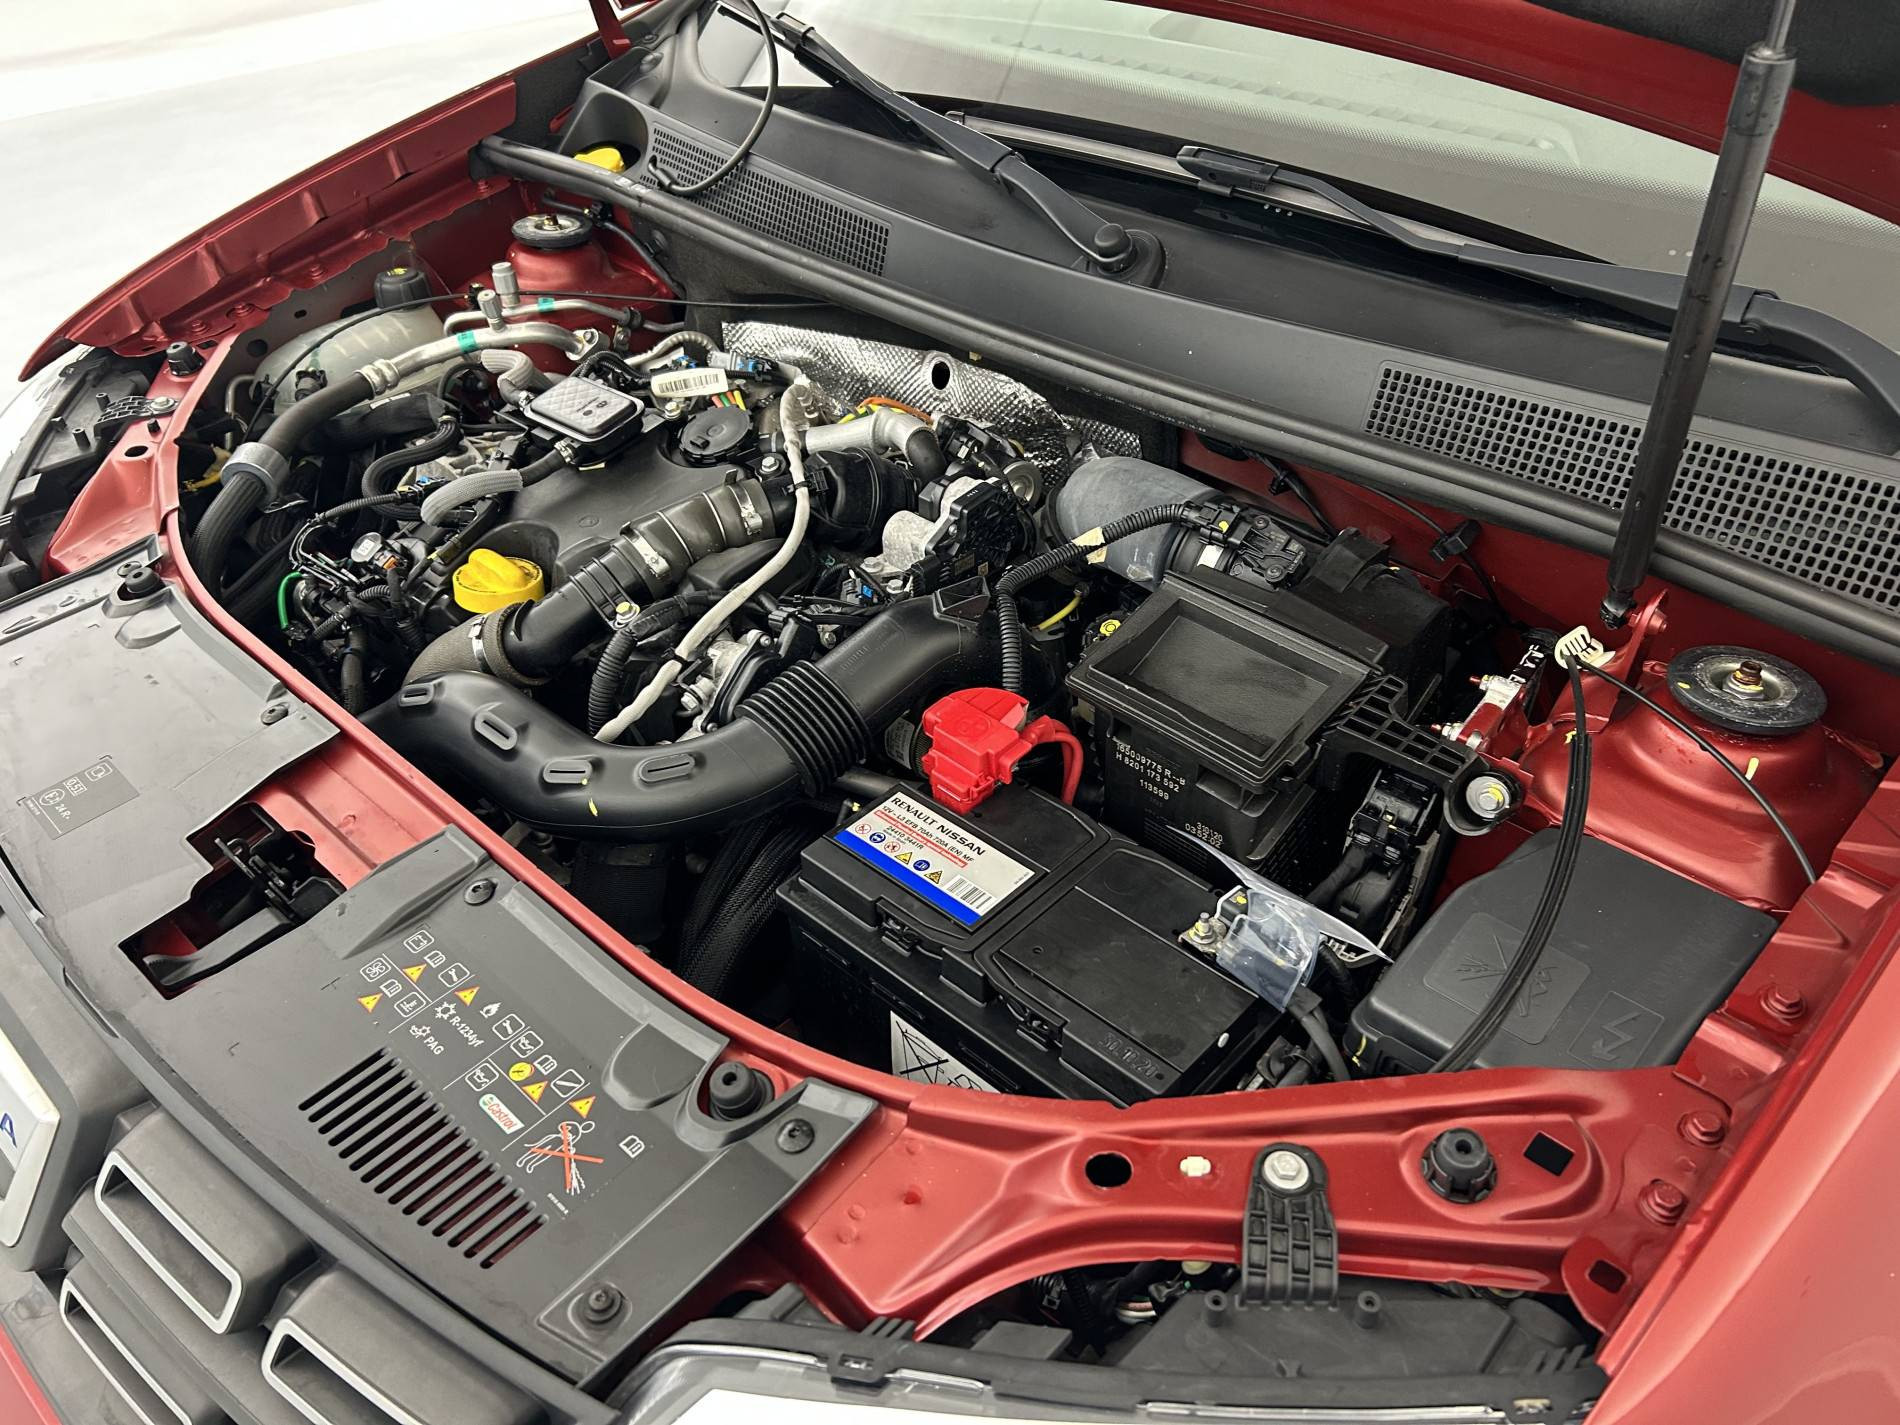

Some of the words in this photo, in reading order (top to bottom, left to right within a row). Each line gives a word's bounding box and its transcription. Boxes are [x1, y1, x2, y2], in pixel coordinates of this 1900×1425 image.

[1116, 752, 1122, 761] H
[1124, 757, 1144, 773] 8201
[1147, 769, 1161, 782] 173
[882, 805, 894, 814] 12V
[905, 818, 918, 829] EFB
[918, 826, 933, 839] 70Ah
[933, 836, 948, 848] 720A
[948, 845, 963, 856] (EN)
[962, 854, 975, 862] MF
[886, 826, 905, 839] 24410
[904, 836, 924, 850] 3441R
[891, 797, 939, 826] RENAULT
[937, 824, 986, 856] NISSAN
[424, 1036, 444, 1055] PAG
[488, 1104, 517, 1130] Castrol
